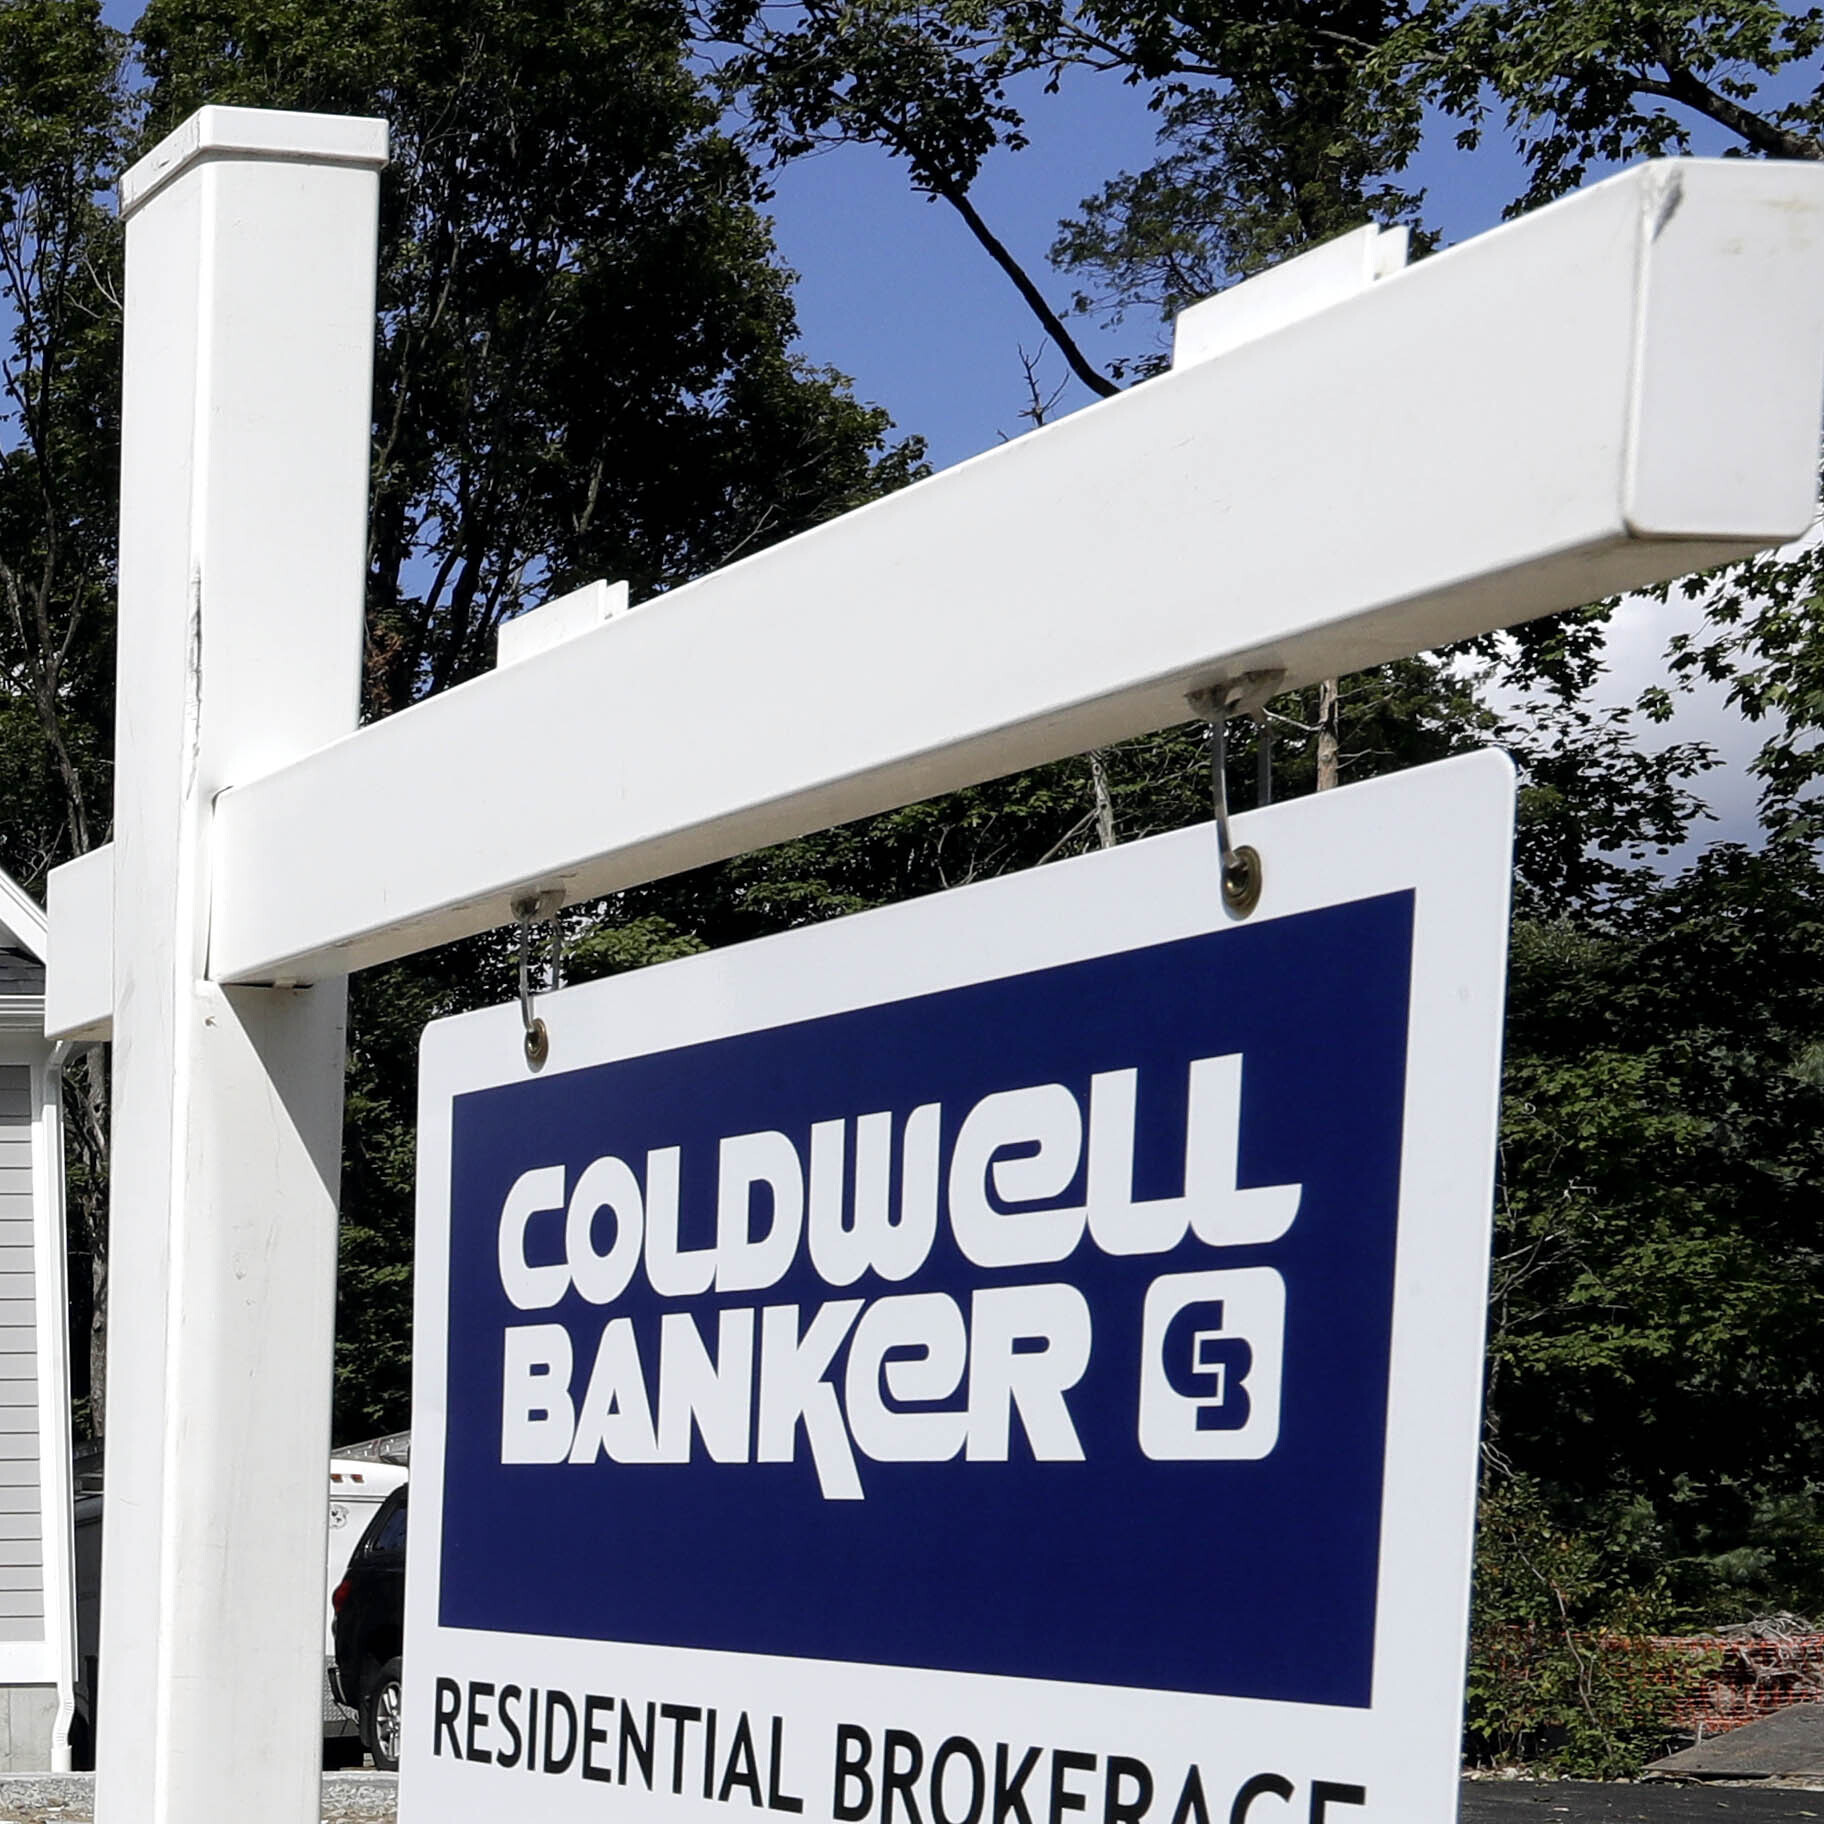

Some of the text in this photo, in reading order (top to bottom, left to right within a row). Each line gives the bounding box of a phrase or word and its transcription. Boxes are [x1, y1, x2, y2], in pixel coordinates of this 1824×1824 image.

[499, 1053, 1302, 1309] COLDWELL
[501, 1283, 1091, 1499] BANKER
[434, 1678, 803, 1813] RESIDENTIAL
